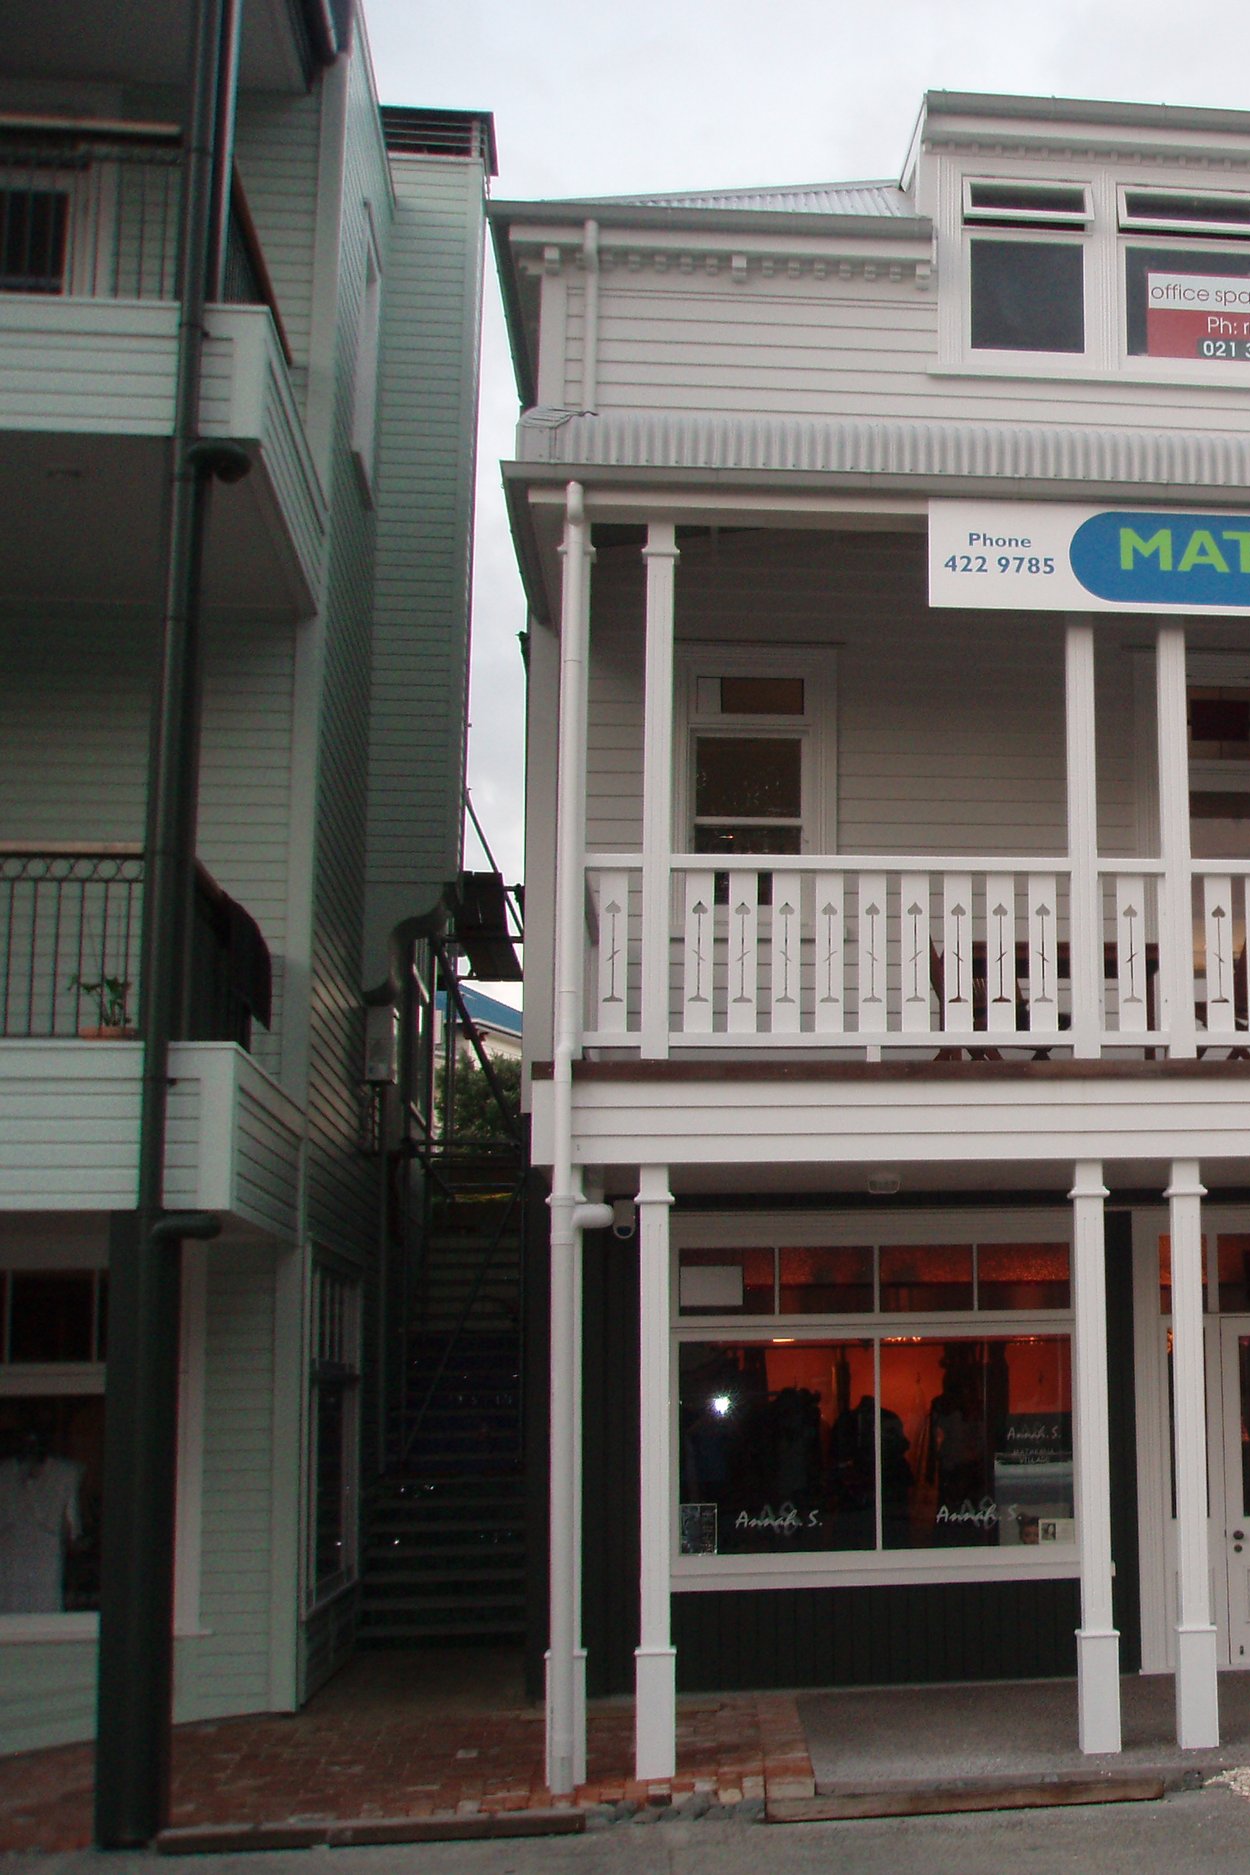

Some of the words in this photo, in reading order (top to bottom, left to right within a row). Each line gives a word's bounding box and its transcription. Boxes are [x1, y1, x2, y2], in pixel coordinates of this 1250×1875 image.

[1151, 284, 1210, 302] office
[1207, 316, 1238, 335] Ph:
[1203, 340, 1236, 358] 021
[968, 532, 1032, 548] Phone
[944, 555, 988, 573] 422
[997, 556, 1055, 575] 9785
